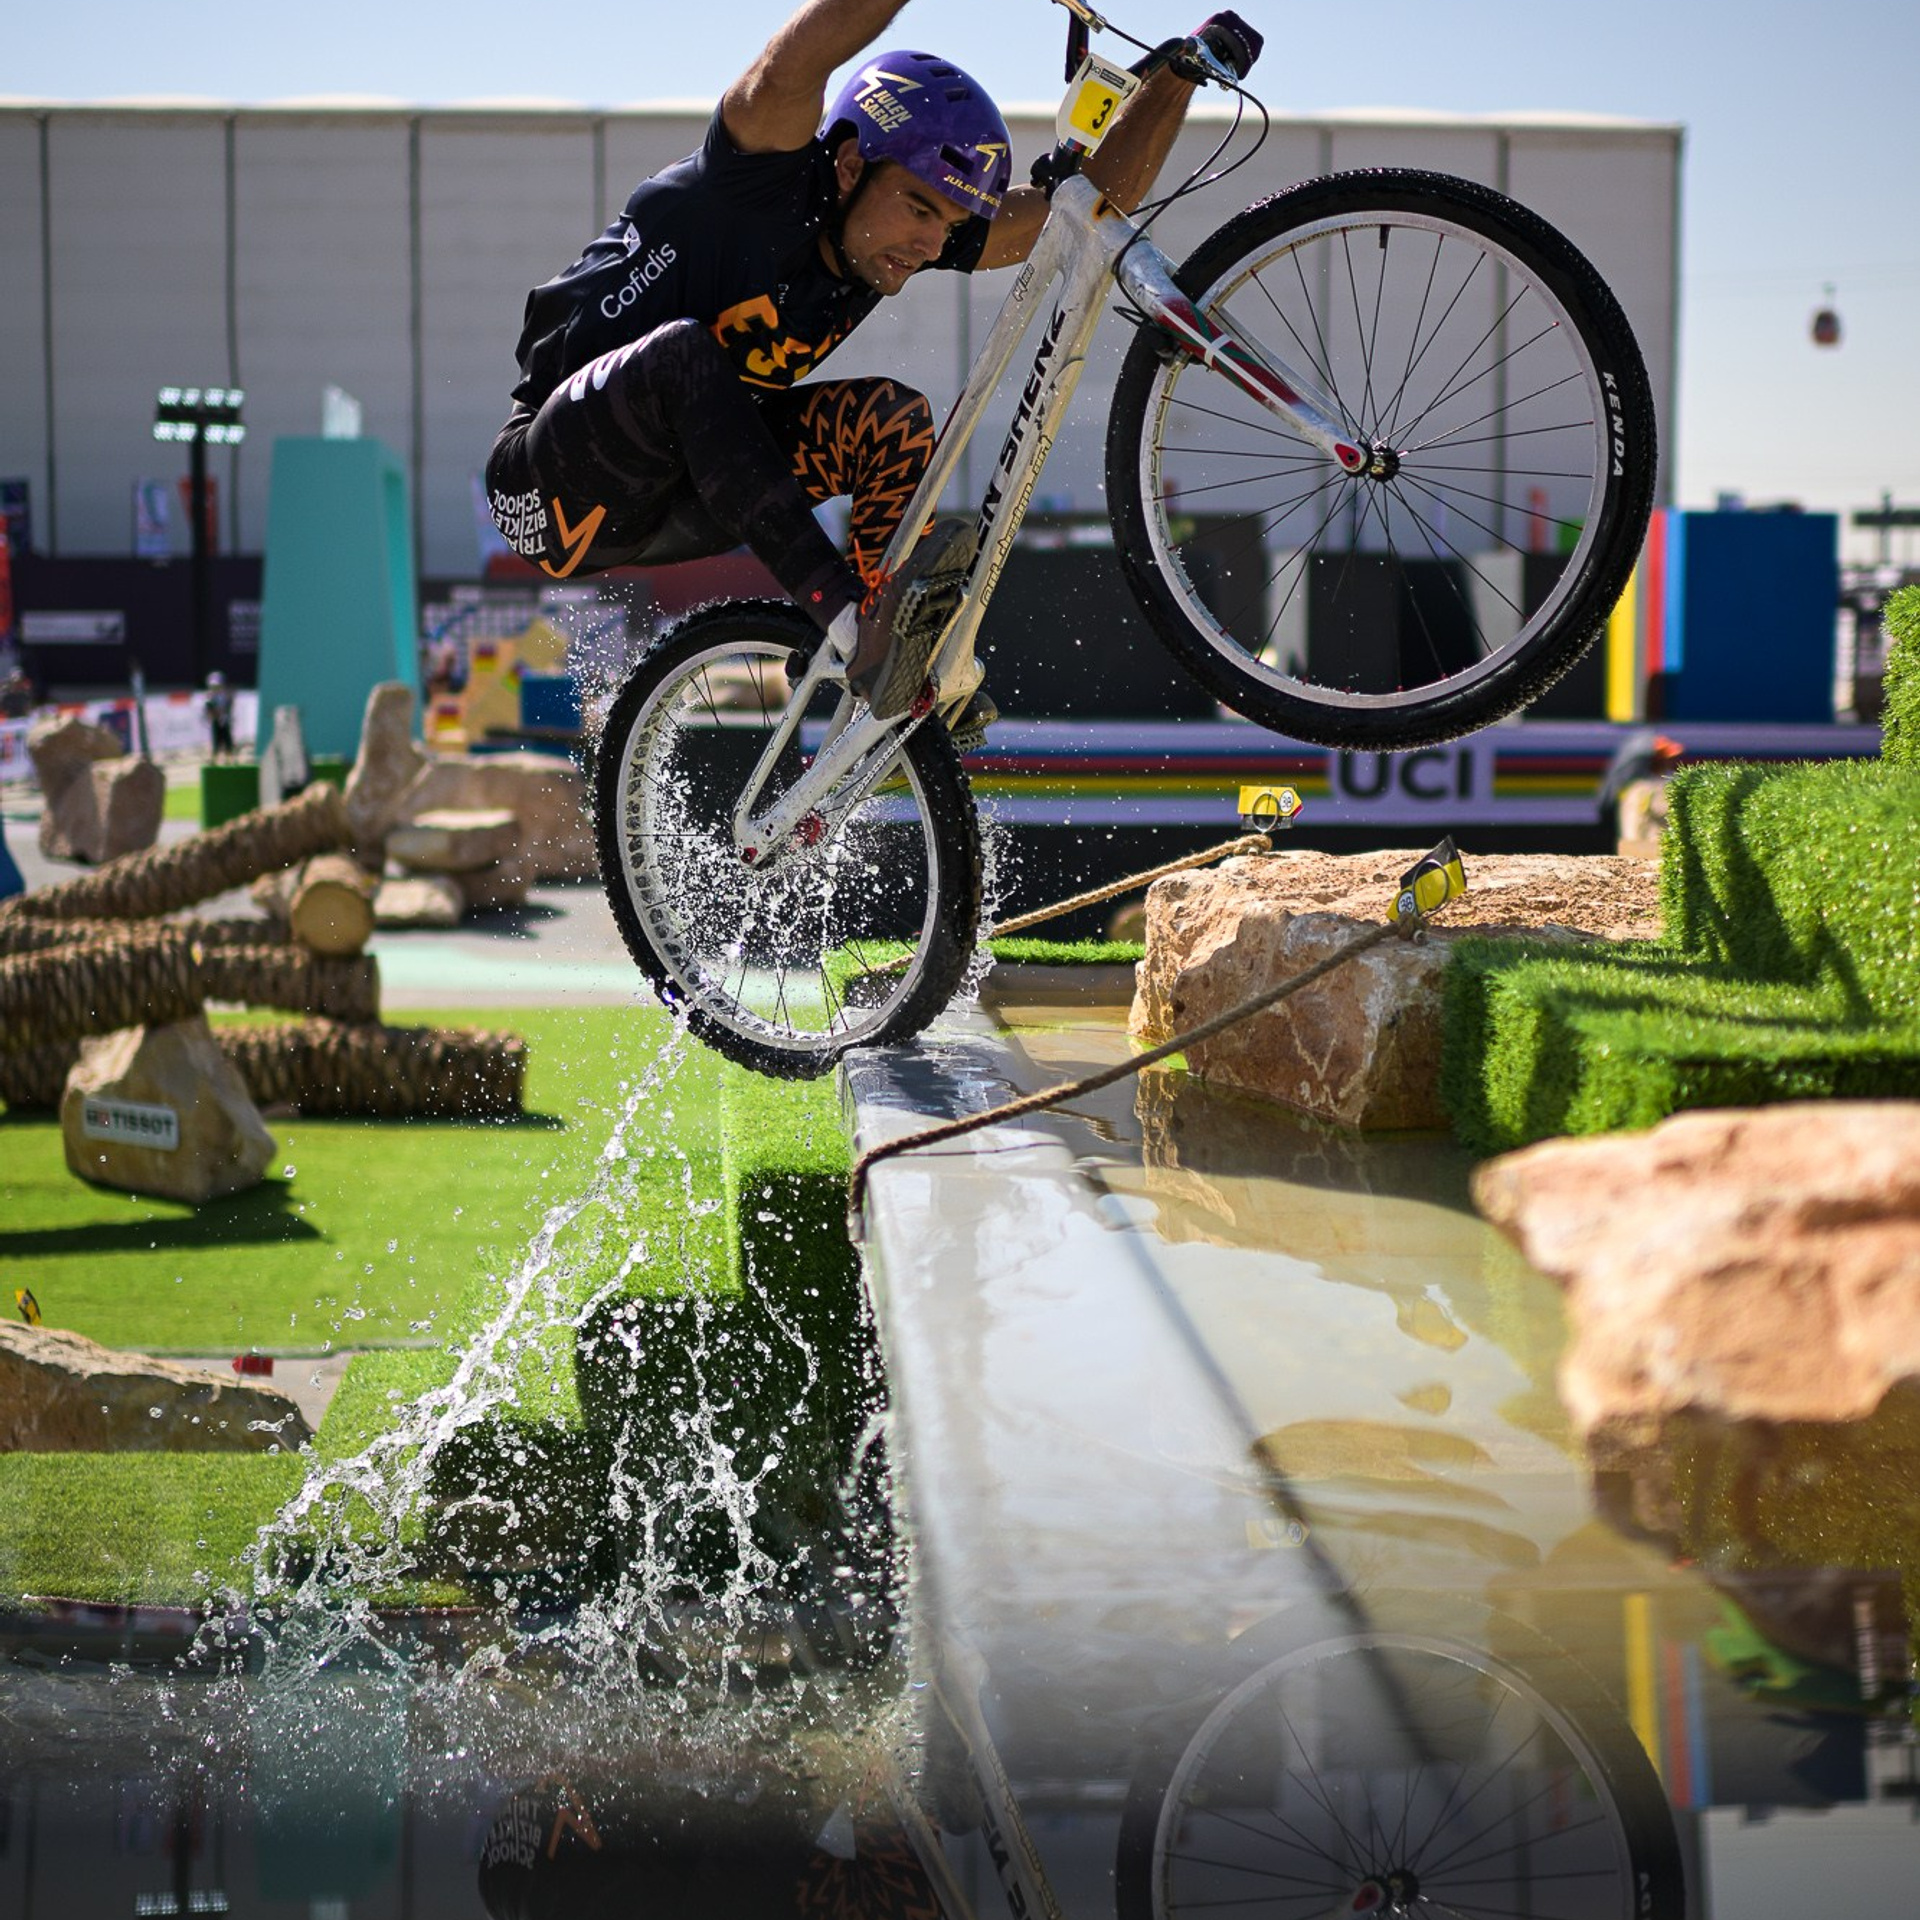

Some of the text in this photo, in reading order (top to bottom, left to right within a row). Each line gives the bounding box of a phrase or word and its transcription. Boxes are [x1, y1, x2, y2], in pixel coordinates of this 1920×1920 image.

[860, 98, 899, 133] SAENZ
[873, 89, 913, 123] JULEN
[1091, 97, 1113, 130] 3
[943, 174, 980, 196] JULEN
[600, 243, 677, 319] Cofidis
[999, 301, 1067, 475] SAENZ
[1603, 371, 1625, 476] KENDA
[494, 488, 541, 515] SCHOOL
[1338, 749, 1475, 804] UCI
[112, 1110, 173, 1137] TISSOT
